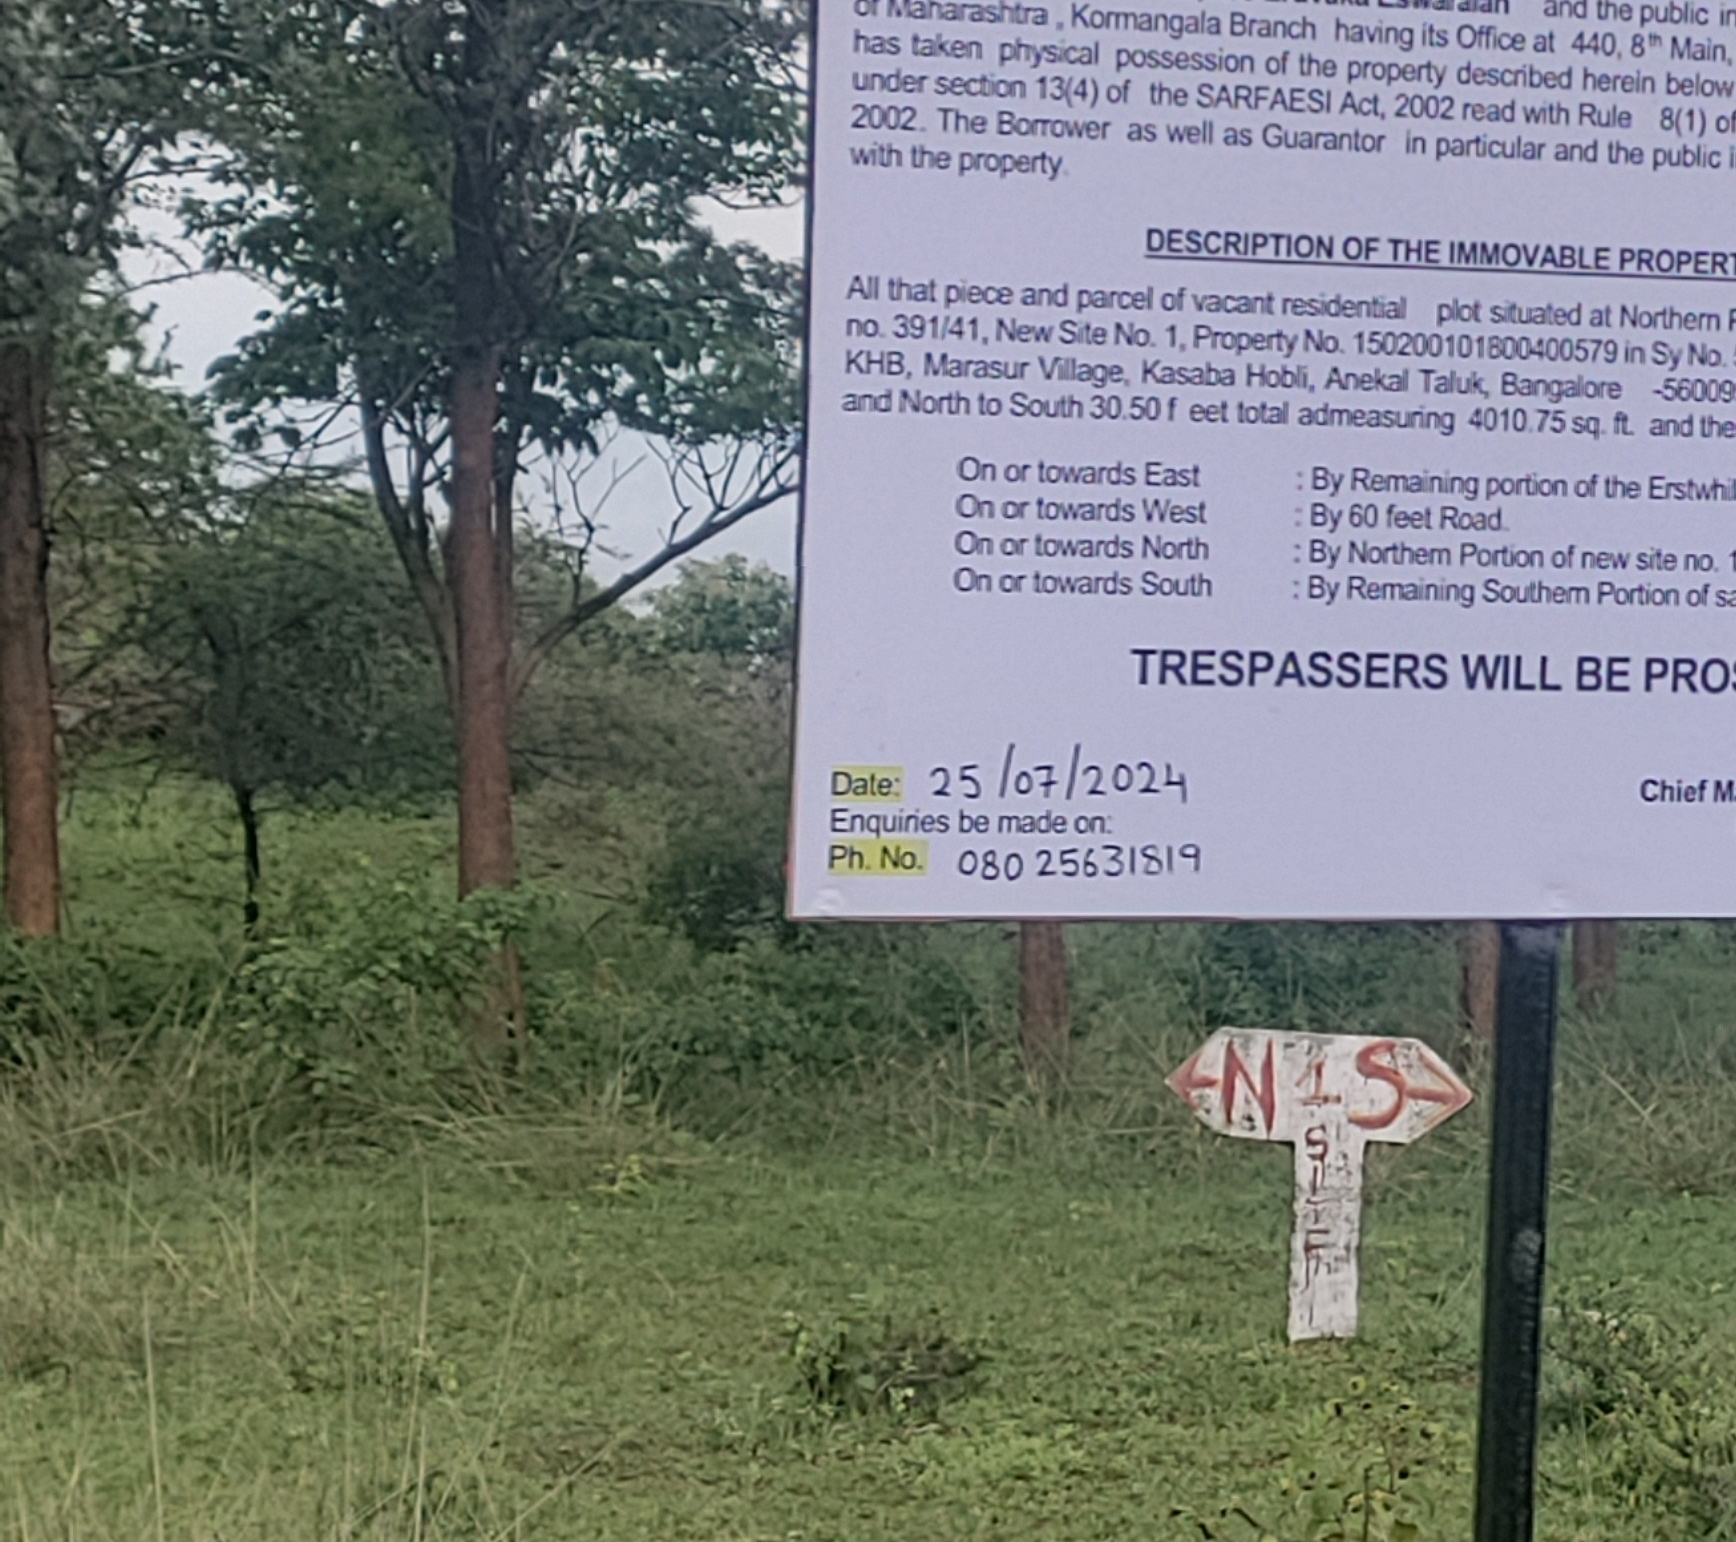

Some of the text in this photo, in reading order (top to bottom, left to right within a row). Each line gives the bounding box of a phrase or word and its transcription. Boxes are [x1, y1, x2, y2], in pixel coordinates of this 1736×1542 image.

[1071, 2, 1223, 42] Kormangala
[1229, 11, 1318, 43] Branch
[1334, 17, 1416, 54] having
[1456, 23, 1528, 54] Office
[1669, 35, 1734, 68] Main,
[1639, 0, 1711, 29] public
[910, 32, 984, 61] taken
[998, 37, 1101, 70] physical
[1115, 47, 1257, 76] possession
[1346, 59, 1448, 90] property
[1456, 60, 1575, 92] described
[1581, 65, 1658, 96] herein
[1665, 71, 1736, 100] below
[852, 67, 931, 95] under
[933, 72, 1028, 100] section
[1035, 75, 1101, 111] 13(4)
[1195, 82, 1333, 116] SARFAESI
[996, 110, 1114, 142] Borrower
[1261, 122, 1388, 155] Guarantor
[1435, 132, 1548, 163] particular
[1651, 143, 1723, 173] public
[1145, 227, 1336, 262] DESCRIPTION
[1341, 235, 1383, 263] OF
[1386, 237, 1443, 266] THE
[1448, 240, 1613, 272] IMMOVABLE
[943, 278, 1016, 311] piece
[1075, 285, 1155, 316] parcel
[1190, 292, 1277, 317] vacant
[1281, 292, 1408, 321] residential
[1489, 301, 1583, 328] situated
[1619, 303, 1723, 333] Northern
[892, 313, 990, 347] 391/41,
[1192, 324, 1300, 360] Property
[923, 351, 1032, 381] Marasur
[1141, 358, 1237, 388] Kasaba
[1245, 362, 1317, 395] Hobli,
[1323, 365, 1411, 394] Anekal
[1417, 368, 1492, 401] Taluk,
[1500, 371, 1624, 404] Bangalore
[898, 388, 973, 417] North
[1008, 391, 1086, 421] South
[1235, 400, 1291, 426] total
[1297, 402, 1457, 437] admeasuring
[1037, 459, 1139, 487] towards
[1144, 461, 1202, 489] East
[1350, 466, 1481, 501] Remaining
[1485, 471, 1569, 501] portion
[1035, 496, 1137, 524] towards
[1141, 497, 1209, 526] West
[1348, 502, 1380, 530] 60
[1385, 503, 1435, 532] feet
[1034, 533, 1136, 561] towards
[1141, 534, 1211, 562] North
[1347, 539, 1453, 568] Northern
[1459, 542, 1546, 570] Portion
[1635, 546, 1679, 573] site
[1032, 569, 1135, 597] towards
[1139, 570, 1214, 599] South
[1346, 575, 1477, 608] Remaining
[1481, 577, 1592, 606] Southern
[1596, 581, 1681, 608] Portion
[1129, 648, 1451, 692] TRESPASSERS
[1460, 653, 1565, 693] WILL
[1575, 655, 1634, 694] BE
[830, 770, 902, 799] Date:
[1639, 778, 1711, 804] Chief
[829, 808, 1114, 839] Enquiries be made on:
[827, 843, 873, 872] Ph.
[879, 842, 928, 872] No.
[957, 849, 1025, 883] 080
[1222, 1036, 1276, 1140] N
[1347, 1040, 1408, 1130] S
